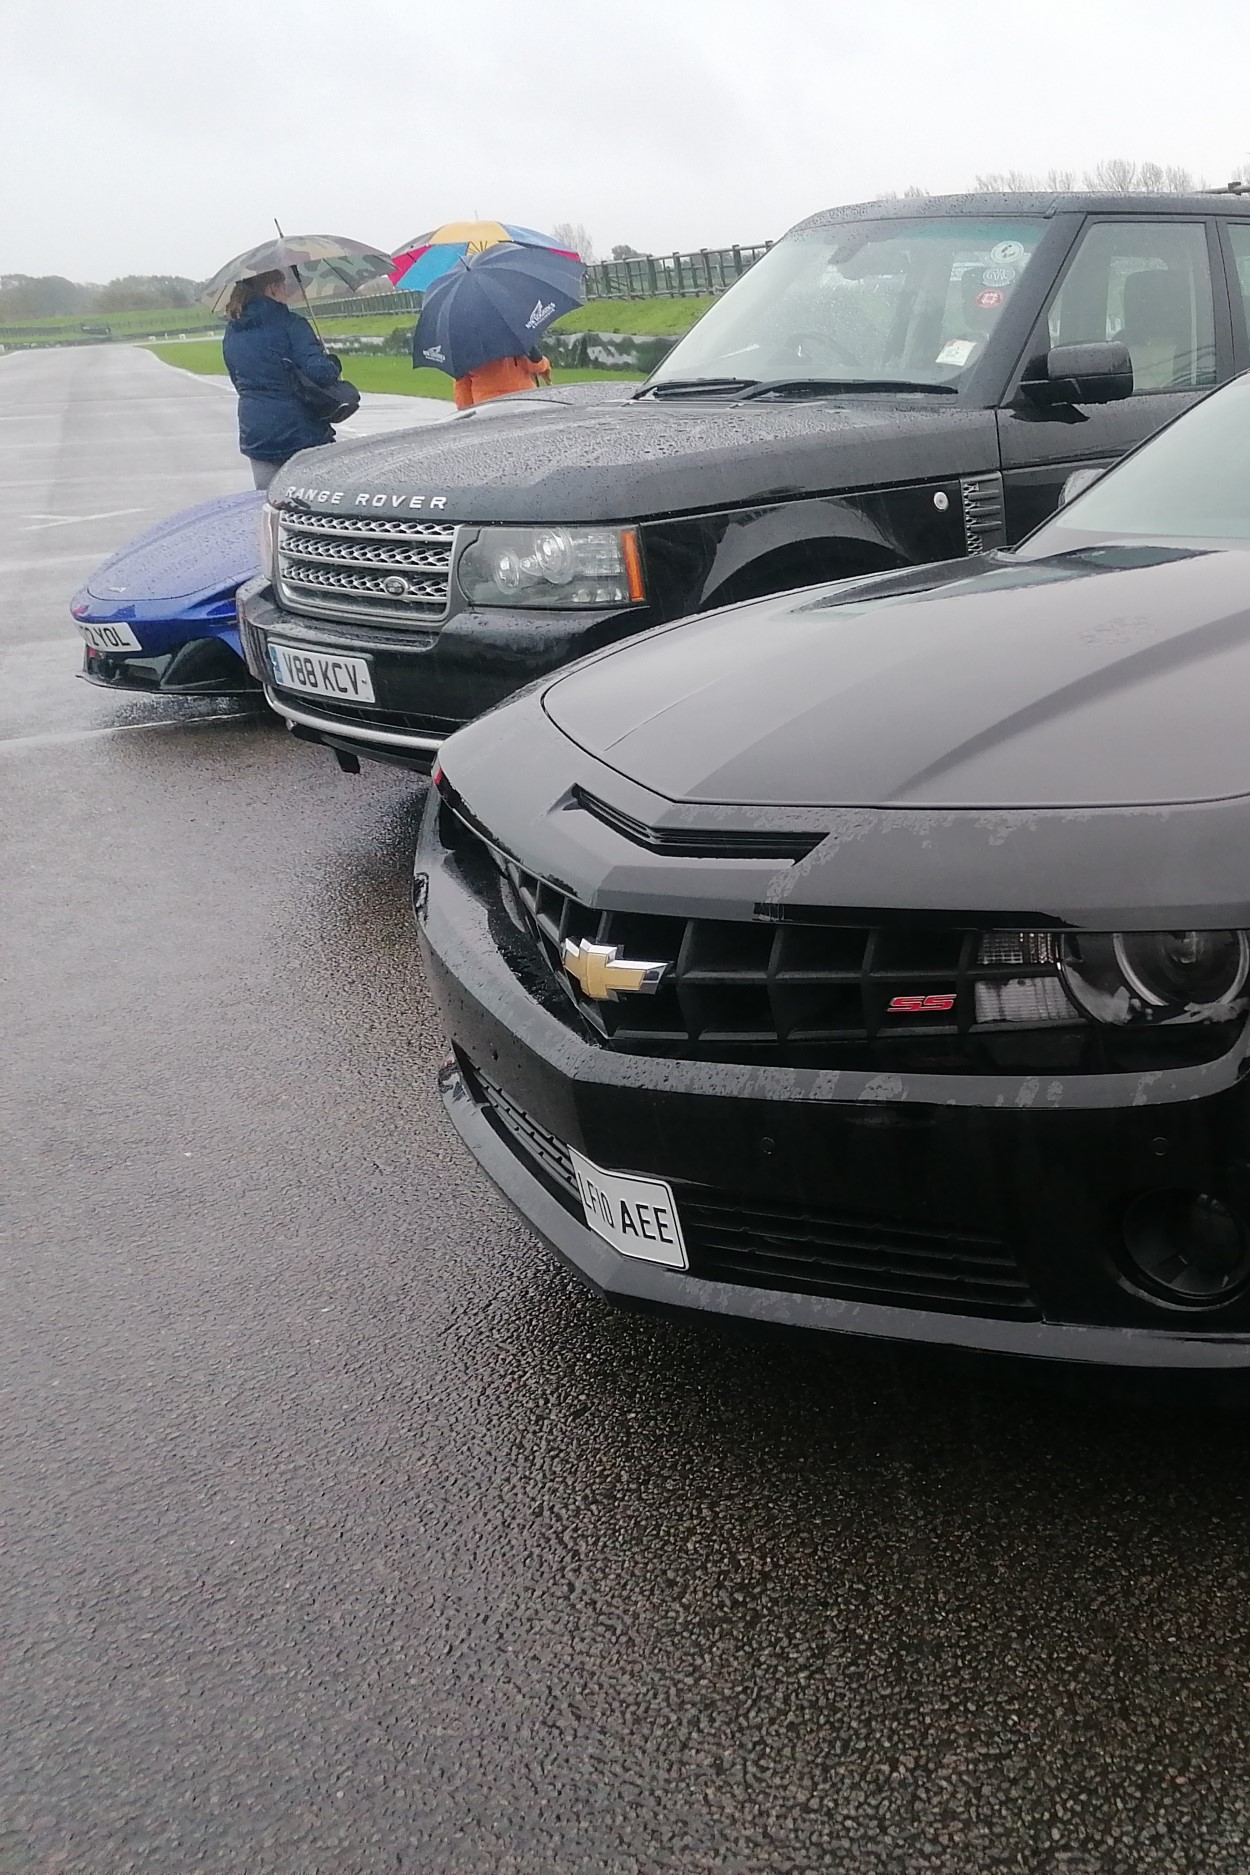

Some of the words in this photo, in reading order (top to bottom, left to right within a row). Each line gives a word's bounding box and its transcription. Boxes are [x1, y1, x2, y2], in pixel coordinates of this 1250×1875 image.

[285, 486, 344, 504] RANGE
[355, 493, 448, 509] ROVER
[93, 627, 132, 648] YOL
[283, 652, 318, 688] V88
[319, 659, 359, 695] KCV
[886, 994, 957, 1012] SS
[577, 1172, 615, 1229] LF10
[620, 1199, 674, 1245] AEE
